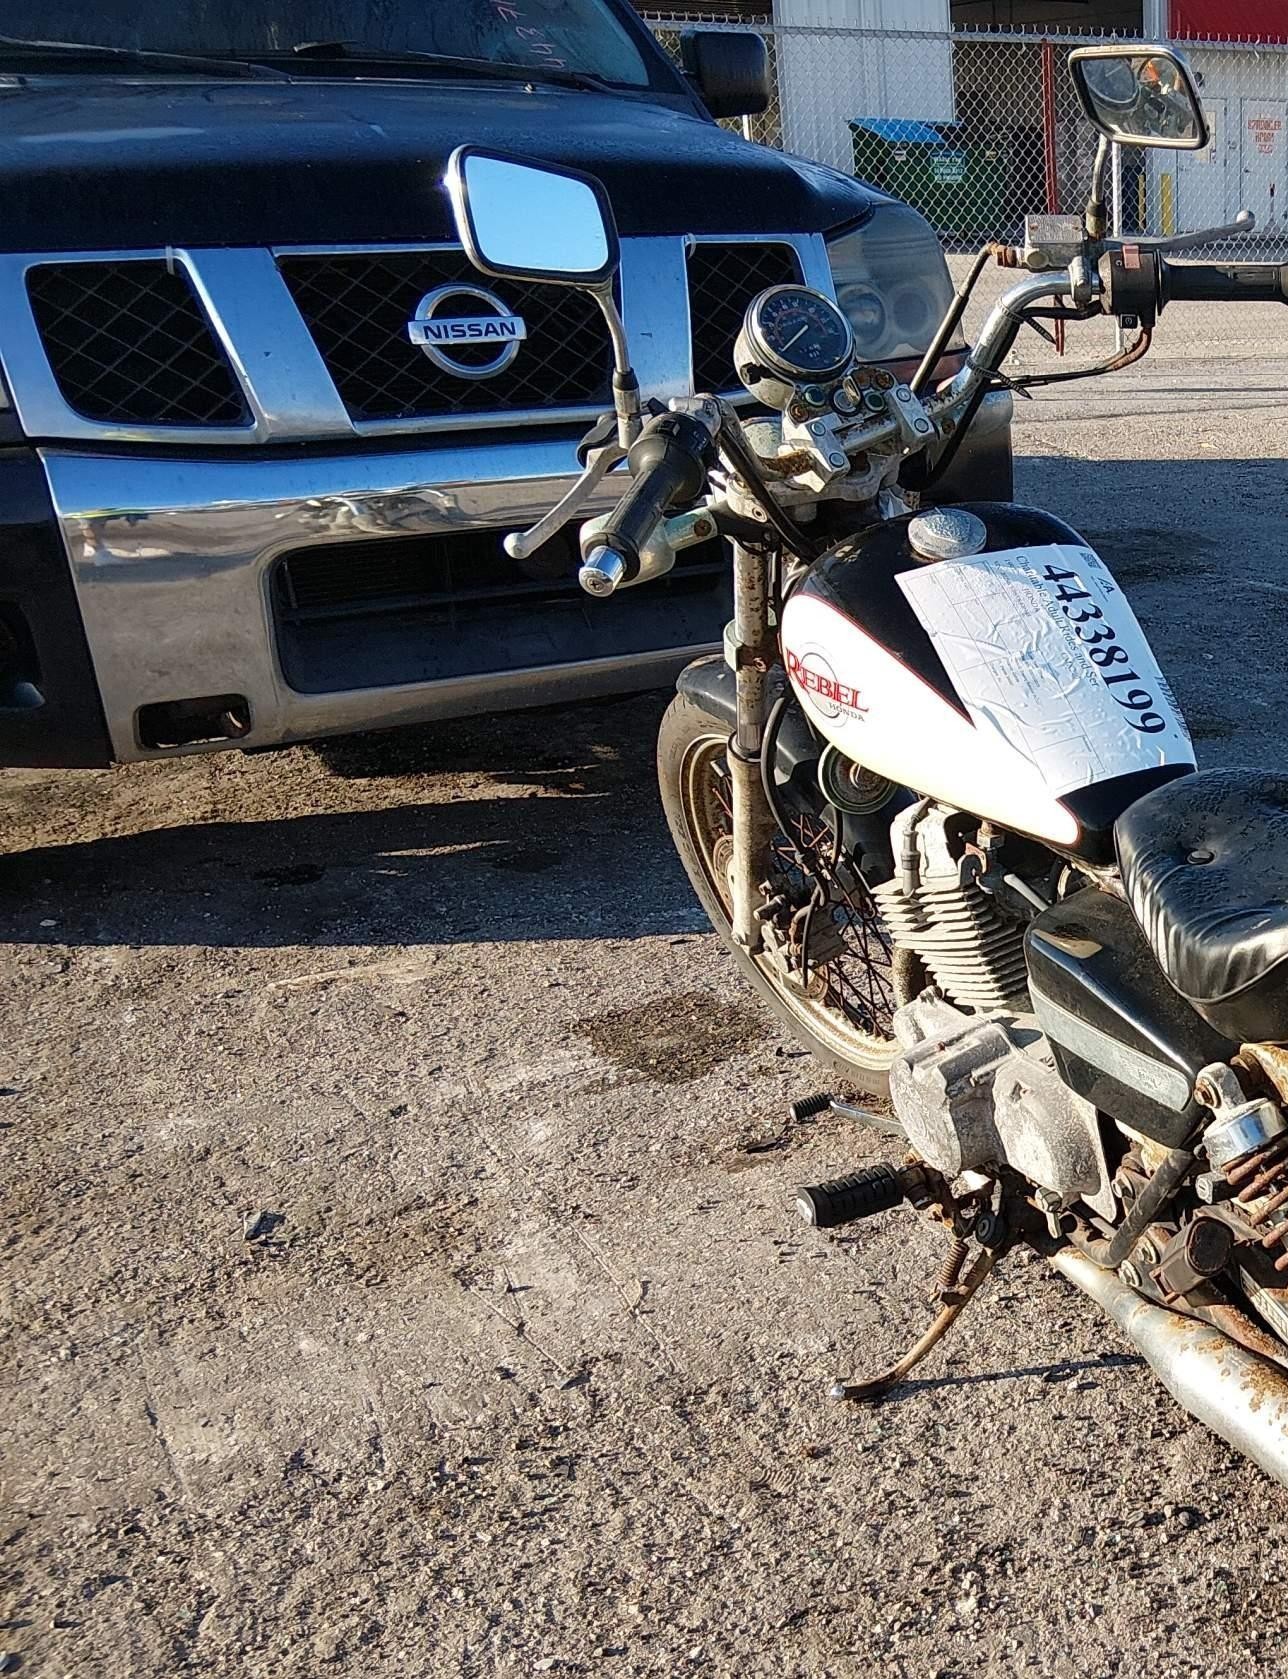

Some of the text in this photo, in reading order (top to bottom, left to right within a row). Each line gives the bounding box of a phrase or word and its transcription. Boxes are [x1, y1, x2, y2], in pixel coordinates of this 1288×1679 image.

[422, 321, 517, 340] NISSAN
[1015, 555, 1100, 687] Charitable Adult Rides and Ser
[1042, 564, 1167, 734] 44338199
[786, 647, 869, 713] REBEL
[828, 702, 865, 722] HONDA
